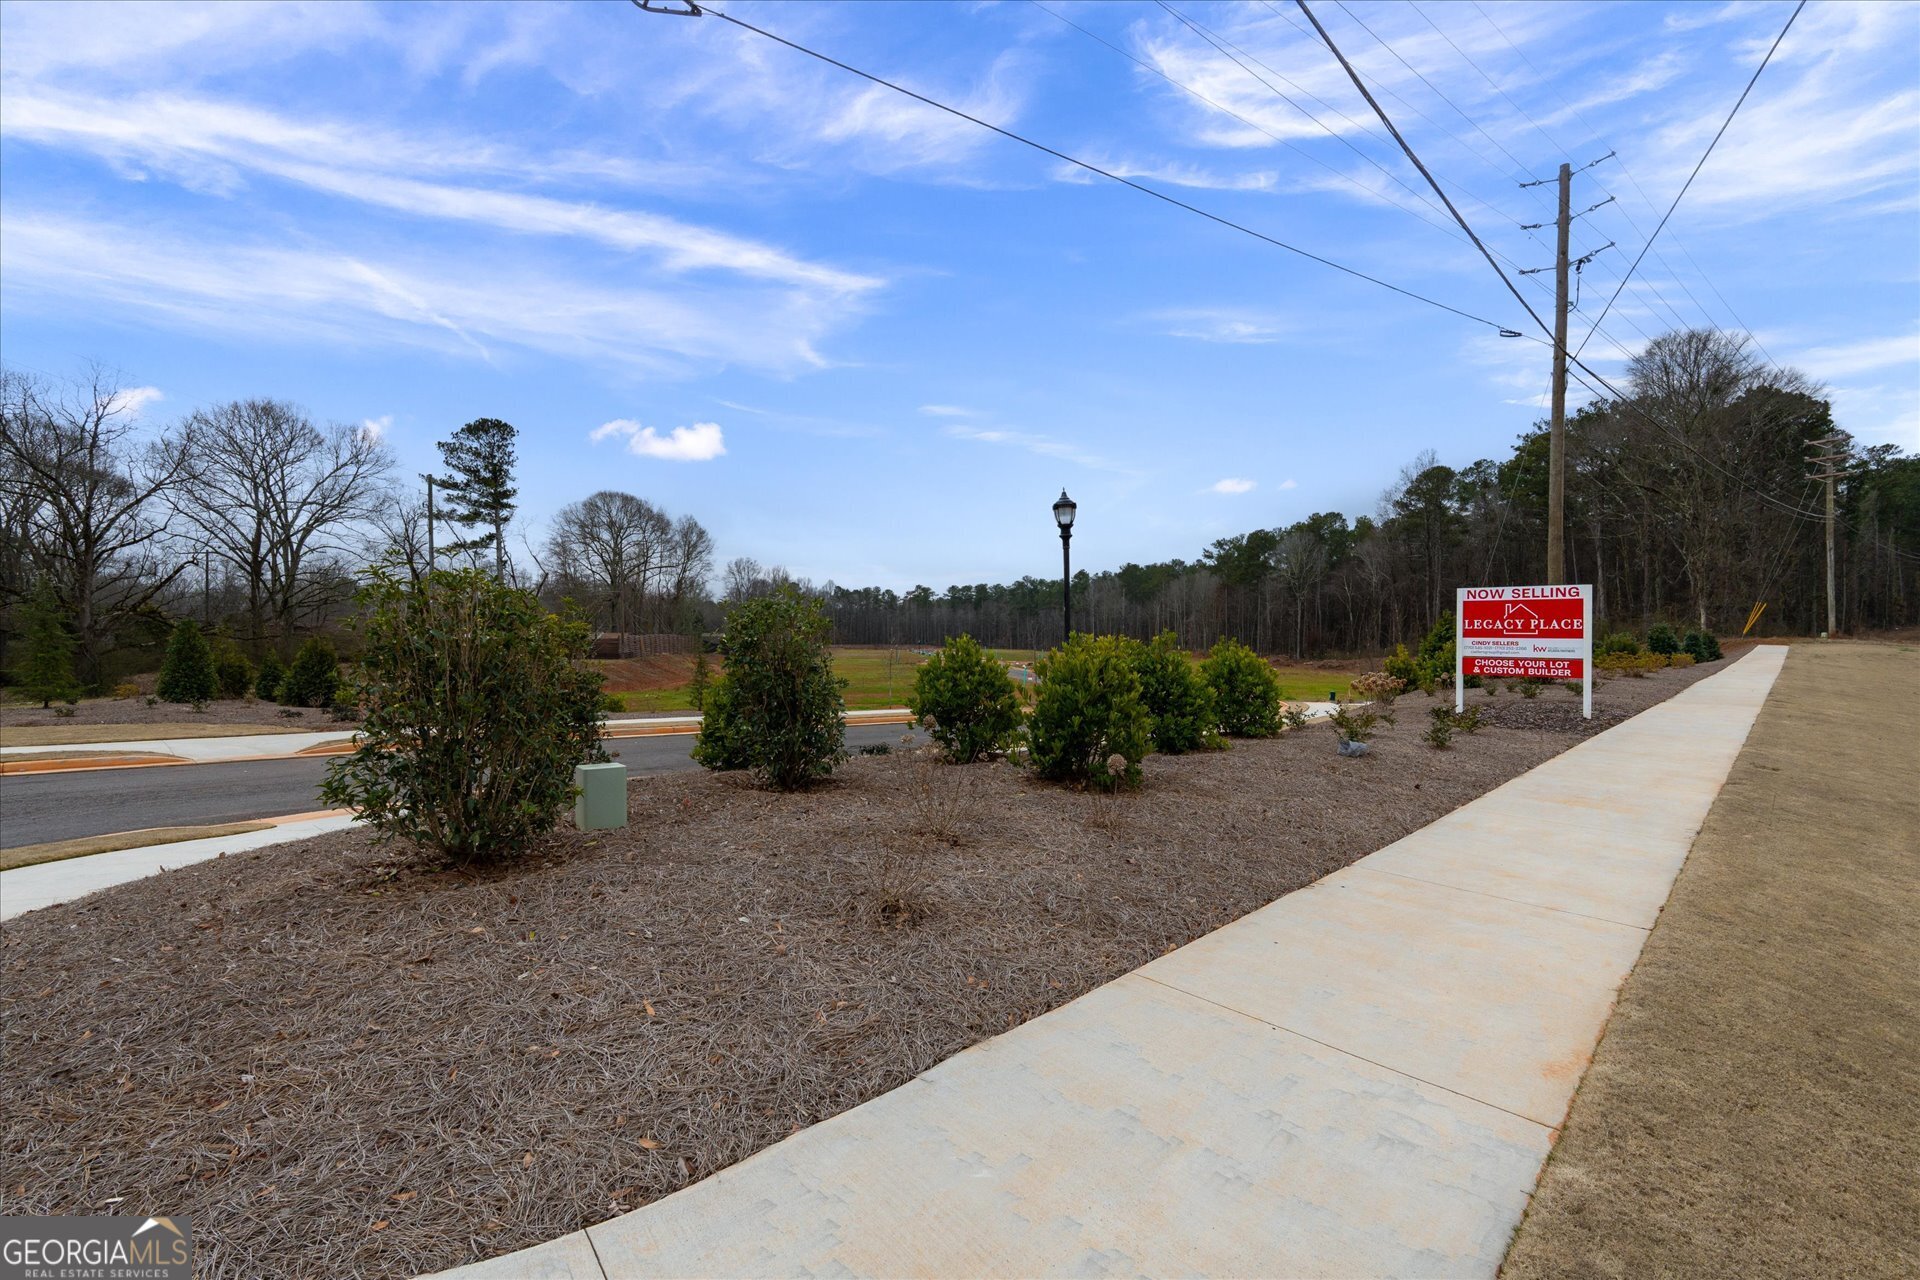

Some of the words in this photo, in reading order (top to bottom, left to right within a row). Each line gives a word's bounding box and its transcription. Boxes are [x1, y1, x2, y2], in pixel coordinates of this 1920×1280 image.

[1466, 589, 1504, 600] NOW
[1512, 586, 1580, 598] SELLING
[1464, 620, 1525, 630] LEGACY
[1530, 618, 1583, 630] PLACE
[1533, 644, 1547, 652] kw
